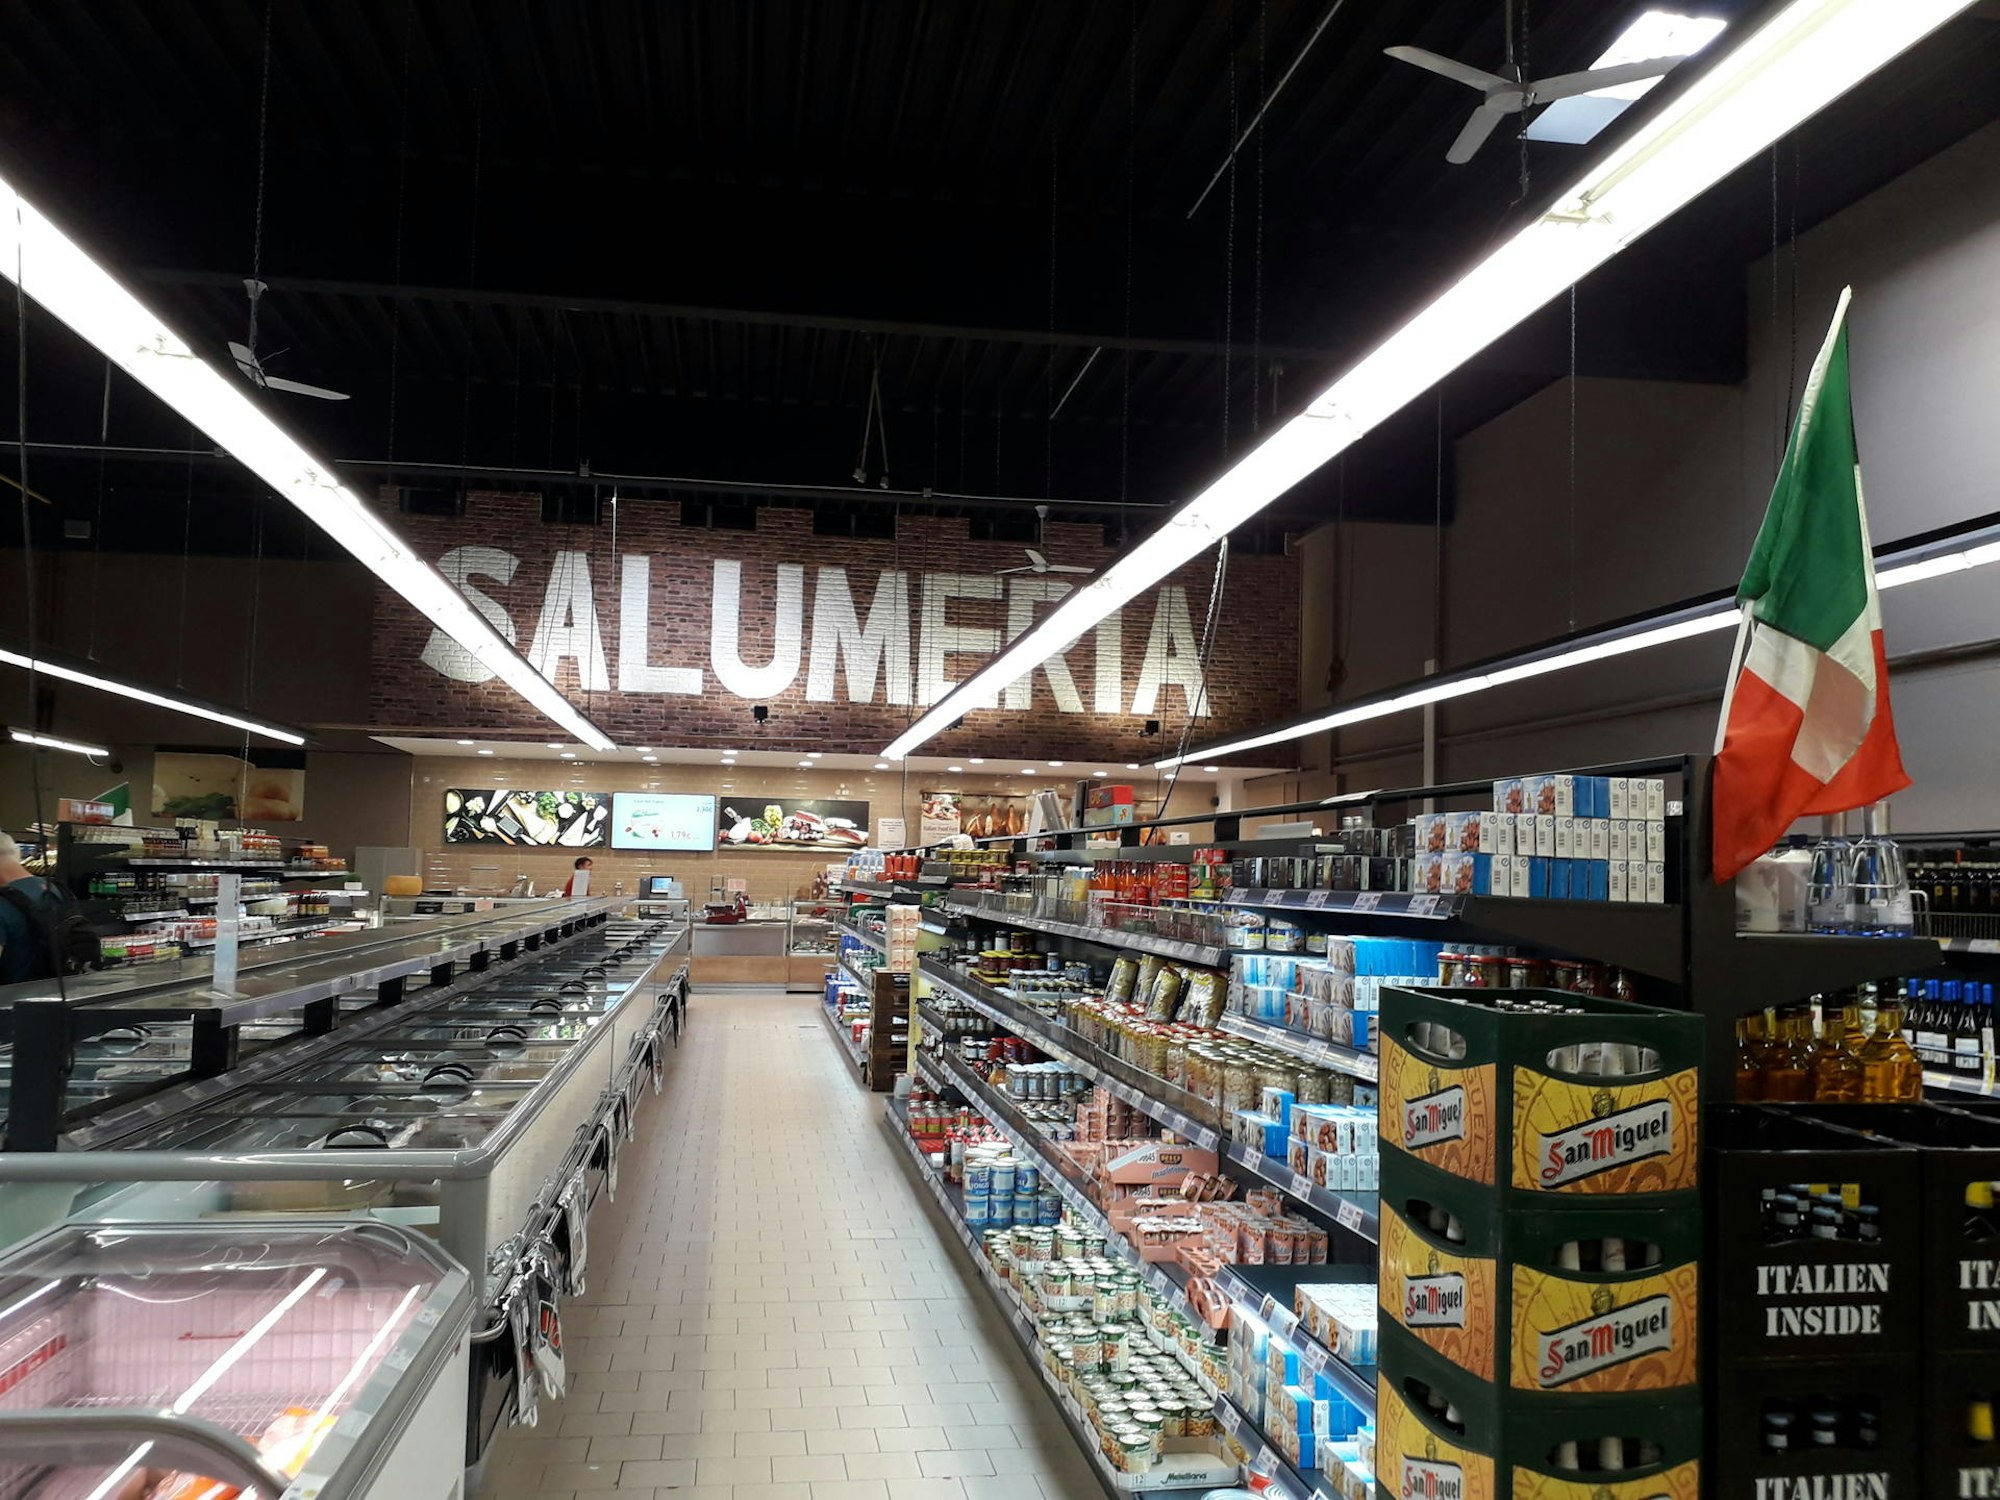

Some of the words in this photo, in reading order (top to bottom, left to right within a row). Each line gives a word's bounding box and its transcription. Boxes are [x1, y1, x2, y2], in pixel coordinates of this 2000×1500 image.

[421, 545, 1212, 717] SALUMERIA
[1756, 1263, 1891, 1296] ITALIEN
[1765, 1304, 1881, 1337] INSIDE
[1754, 1471, 1890, 1500] ITALIEN
